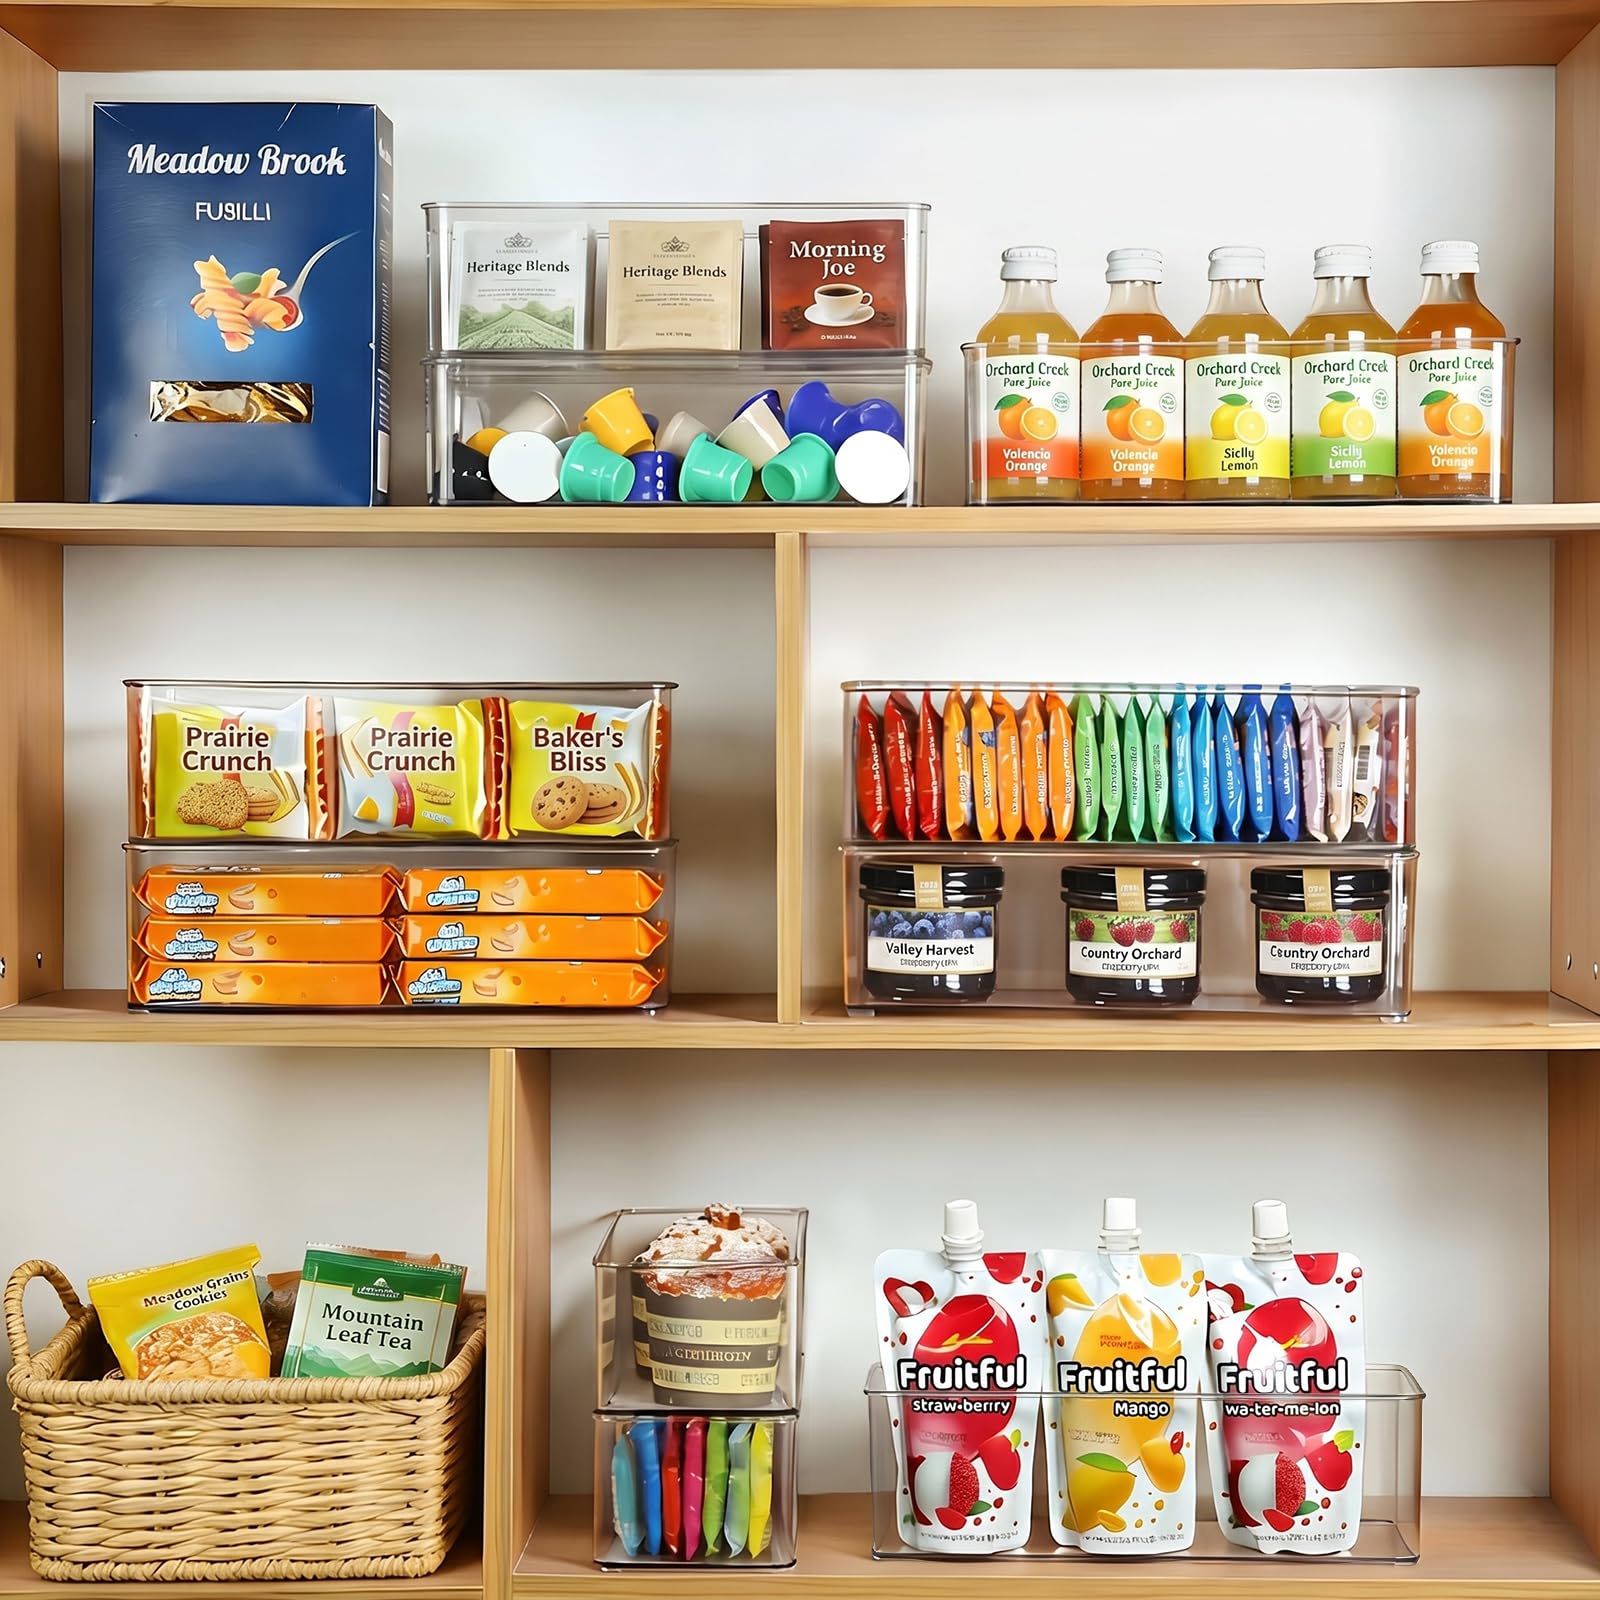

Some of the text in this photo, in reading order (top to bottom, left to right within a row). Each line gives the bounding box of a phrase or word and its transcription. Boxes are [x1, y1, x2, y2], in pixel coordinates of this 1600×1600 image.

[127, 143, 347, 176] Meadow Brook
[195, 201, 272, 221] FUSILLI
[789, 239, 886, 263] Morning
[526, 260, 570, 273] Blends
[623, 265, 727, 280] Heritage Blends
[822, 259, 856, 280] Joe
[985, 362, 1034, 377] Orchard
[1092, 362, 1141, 378] Orchard
[1196, 361, 1247, 377] Orchard
[1304, 358, 1355, 374] Orchard
[1409, 356, 1460, 372] Orchard
[1005, 460, 1048, 473] Orange
[1113, 460, 1155, 474] Orange
[1221, 460, 1258, 471] Lemon
[1328, 458, 1367, 469] Lemon
[1431, 455, 1475, 470] Orange
[186, 725, 270, 748] Prairie
[371, 725, 453, 748] Prairie
[533, 725, 624, 748] Baker's
[182, 750, 273, 772] Crunch
[367, 750, 455, 772] Crunch
[551, 750, 607, 772] Bliss
[886, 942, 975, 958] Valley Harvest
[1081, 946, 1182, 963] Country Orchard
[1321, 946, 1371, 959] Orchard
[206, 1270, 250, 1290] Grains
[174, 1289, 228, 1311] Cookies
[322, 1303, 424, 1332] Mountain
[326, 1324, 412, 1351] Leaf Tea
[900, 1356, 1025, 1390] Fruitful
[1060, 1358, 1187, 1392] Fruitful
[1220, 1358, 1347, 1393] Fruitful
[1114, 1401, 1170, 1418] Mango
